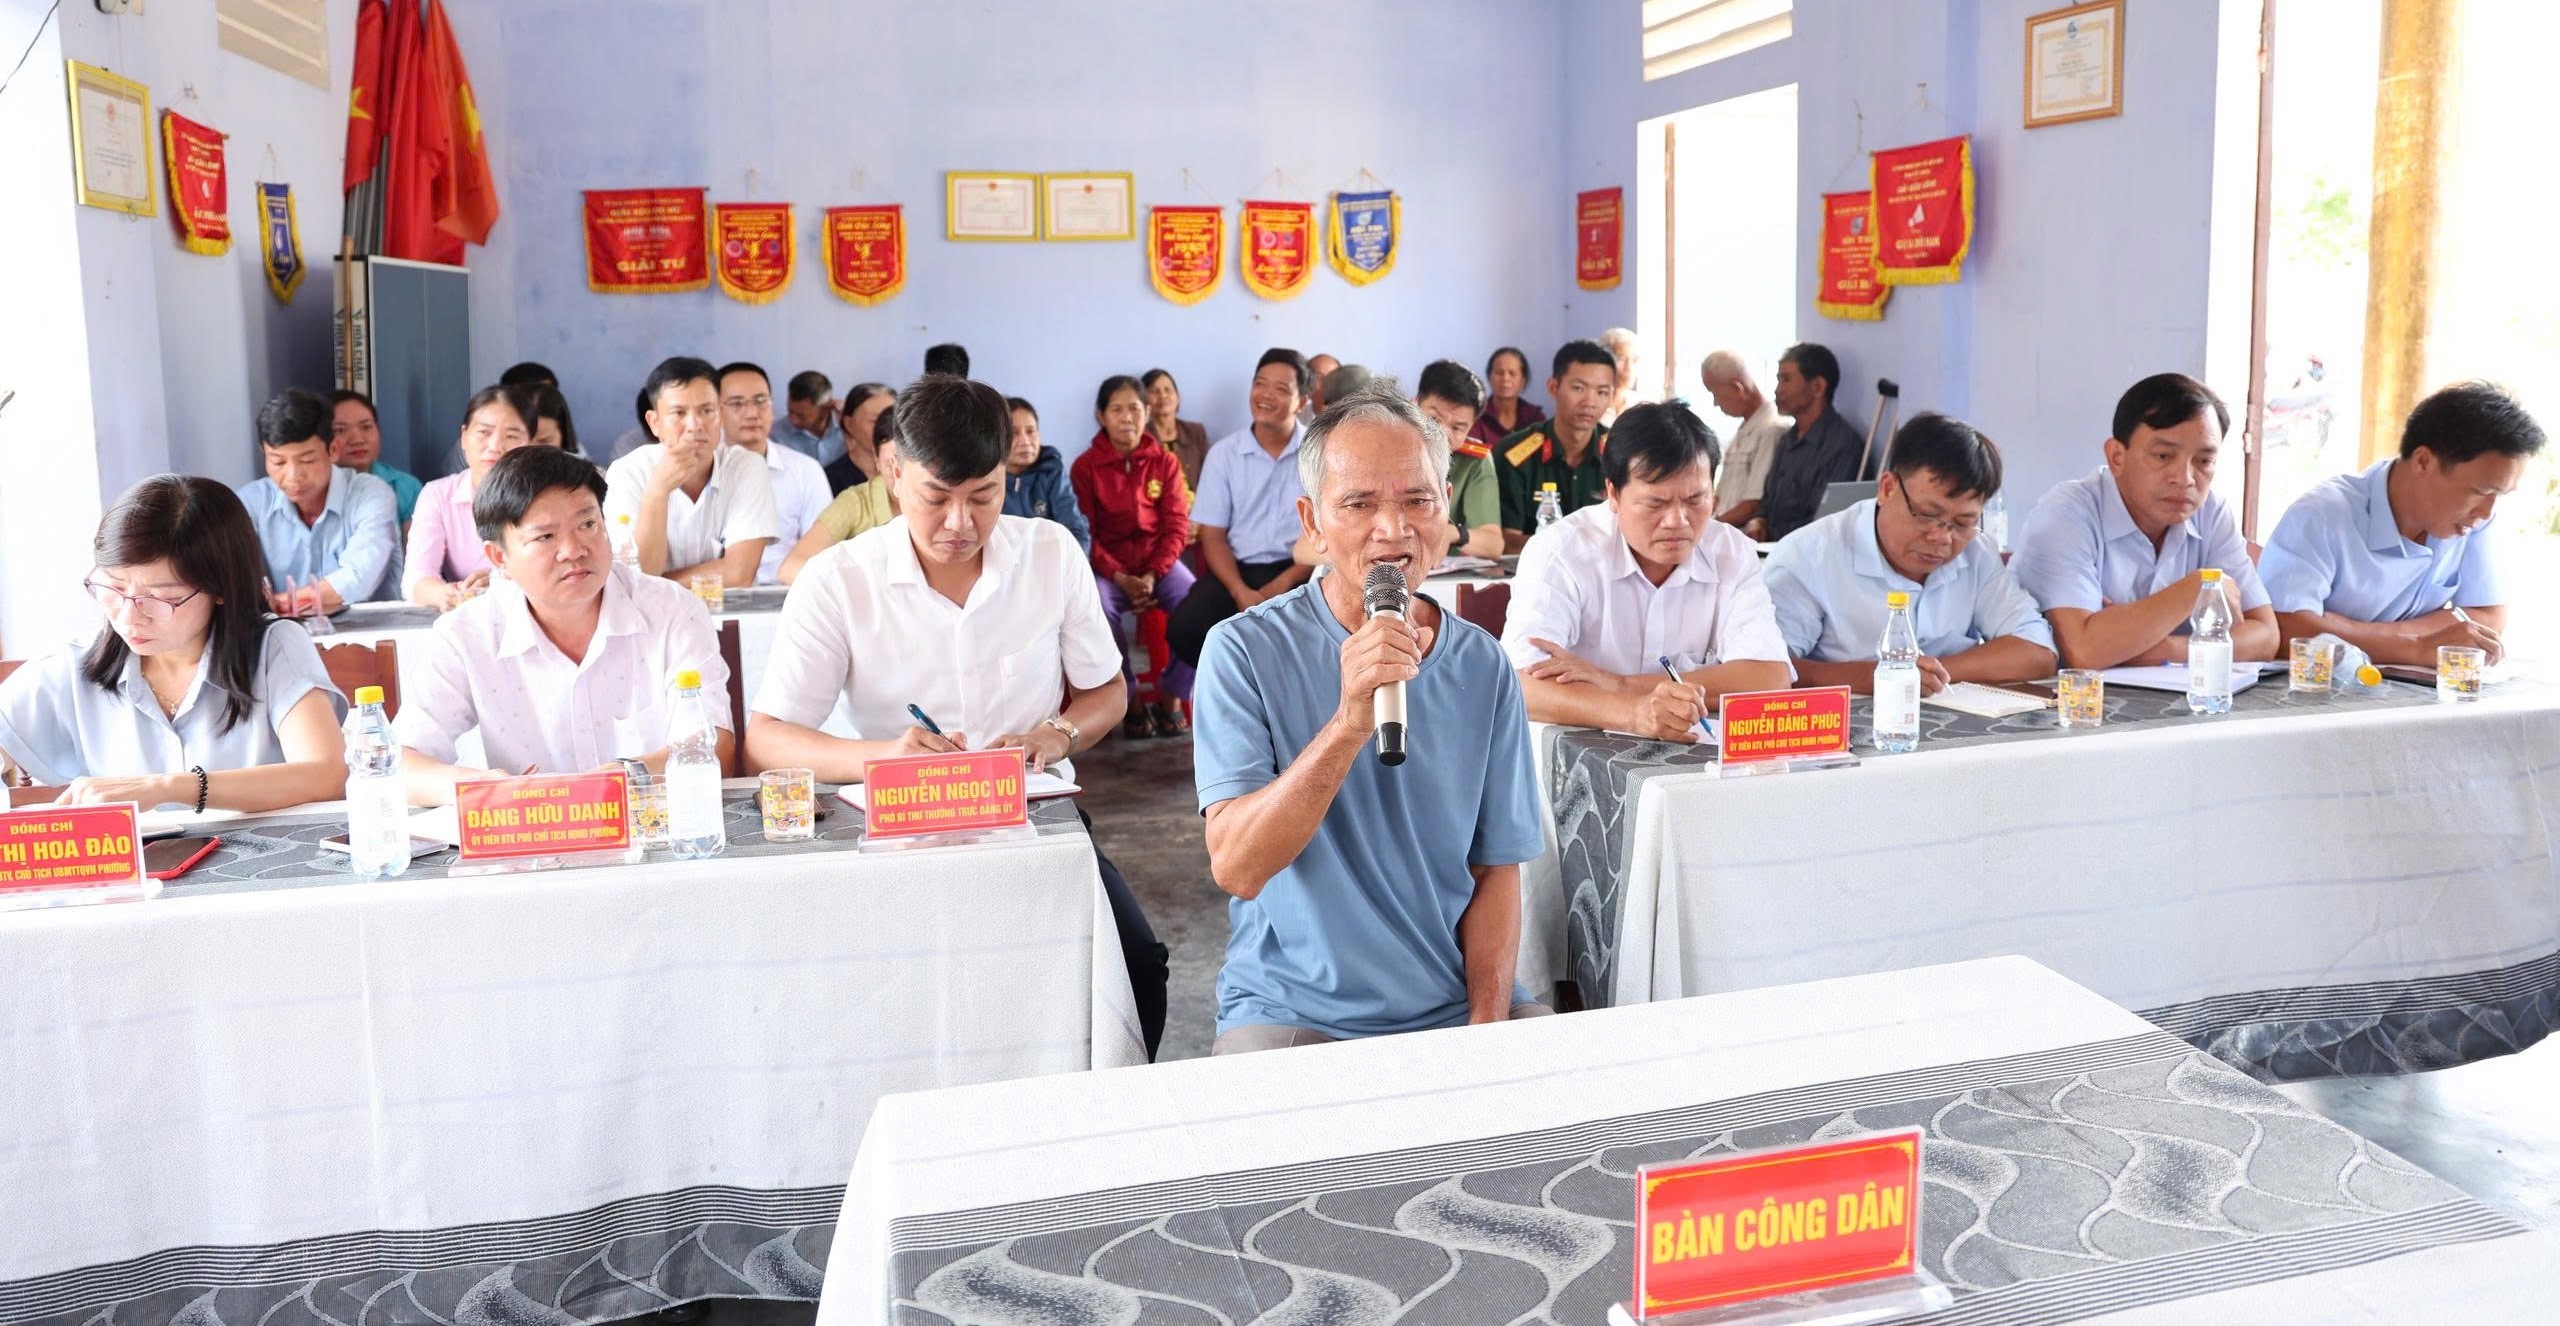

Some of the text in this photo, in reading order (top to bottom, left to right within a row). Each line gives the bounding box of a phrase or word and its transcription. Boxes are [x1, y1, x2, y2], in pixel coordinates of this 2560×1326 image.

[1791, 699, 1807, 710] CHÍ
[1729, 711, 1841, 736] NGUYỄN ĐĂNG PHÚC
[918, 764, 971, 778] ĐỒNG CHÍ
[549, 785, 570, 798] CHÍ
[874, 775, 1017, 807] NGUYỄN NGỌC VŨ
[467, 801, 620, 832] ĐẶNG HỮU DANH
[879, 811, 896, 823] PHÓ
[907, 809, 923, 820] THƯ
[924, 806, 956, 819] THƯỜNG
[957, 806, 978, 818] TRỰC
[979, 802, 1002, 815] ĐẢNG
[1003, 801, 1014, 814] ỦY
[10, 820, 73, 835] ĐỒNG CHÍ
[482, 832, 500, 845] VIÊN
[517, 830, 532, 842] PHÓ
[533, 828, 548, 841] CHỦ
[550, 829, 567, 841] TỊCH
[590, 825, 619, 839] PHƯỜNG
[0, 833, 131, 865] HỊ HOA ĐÀO
[15, 865, 31, 879] CHỦ
[34, 867, 52, 881] TỊCH
[98, 861, 131, 874] PHƯỜNG
[1653, 1181, 1905, 1264] BÀN CÔNG DÂN
